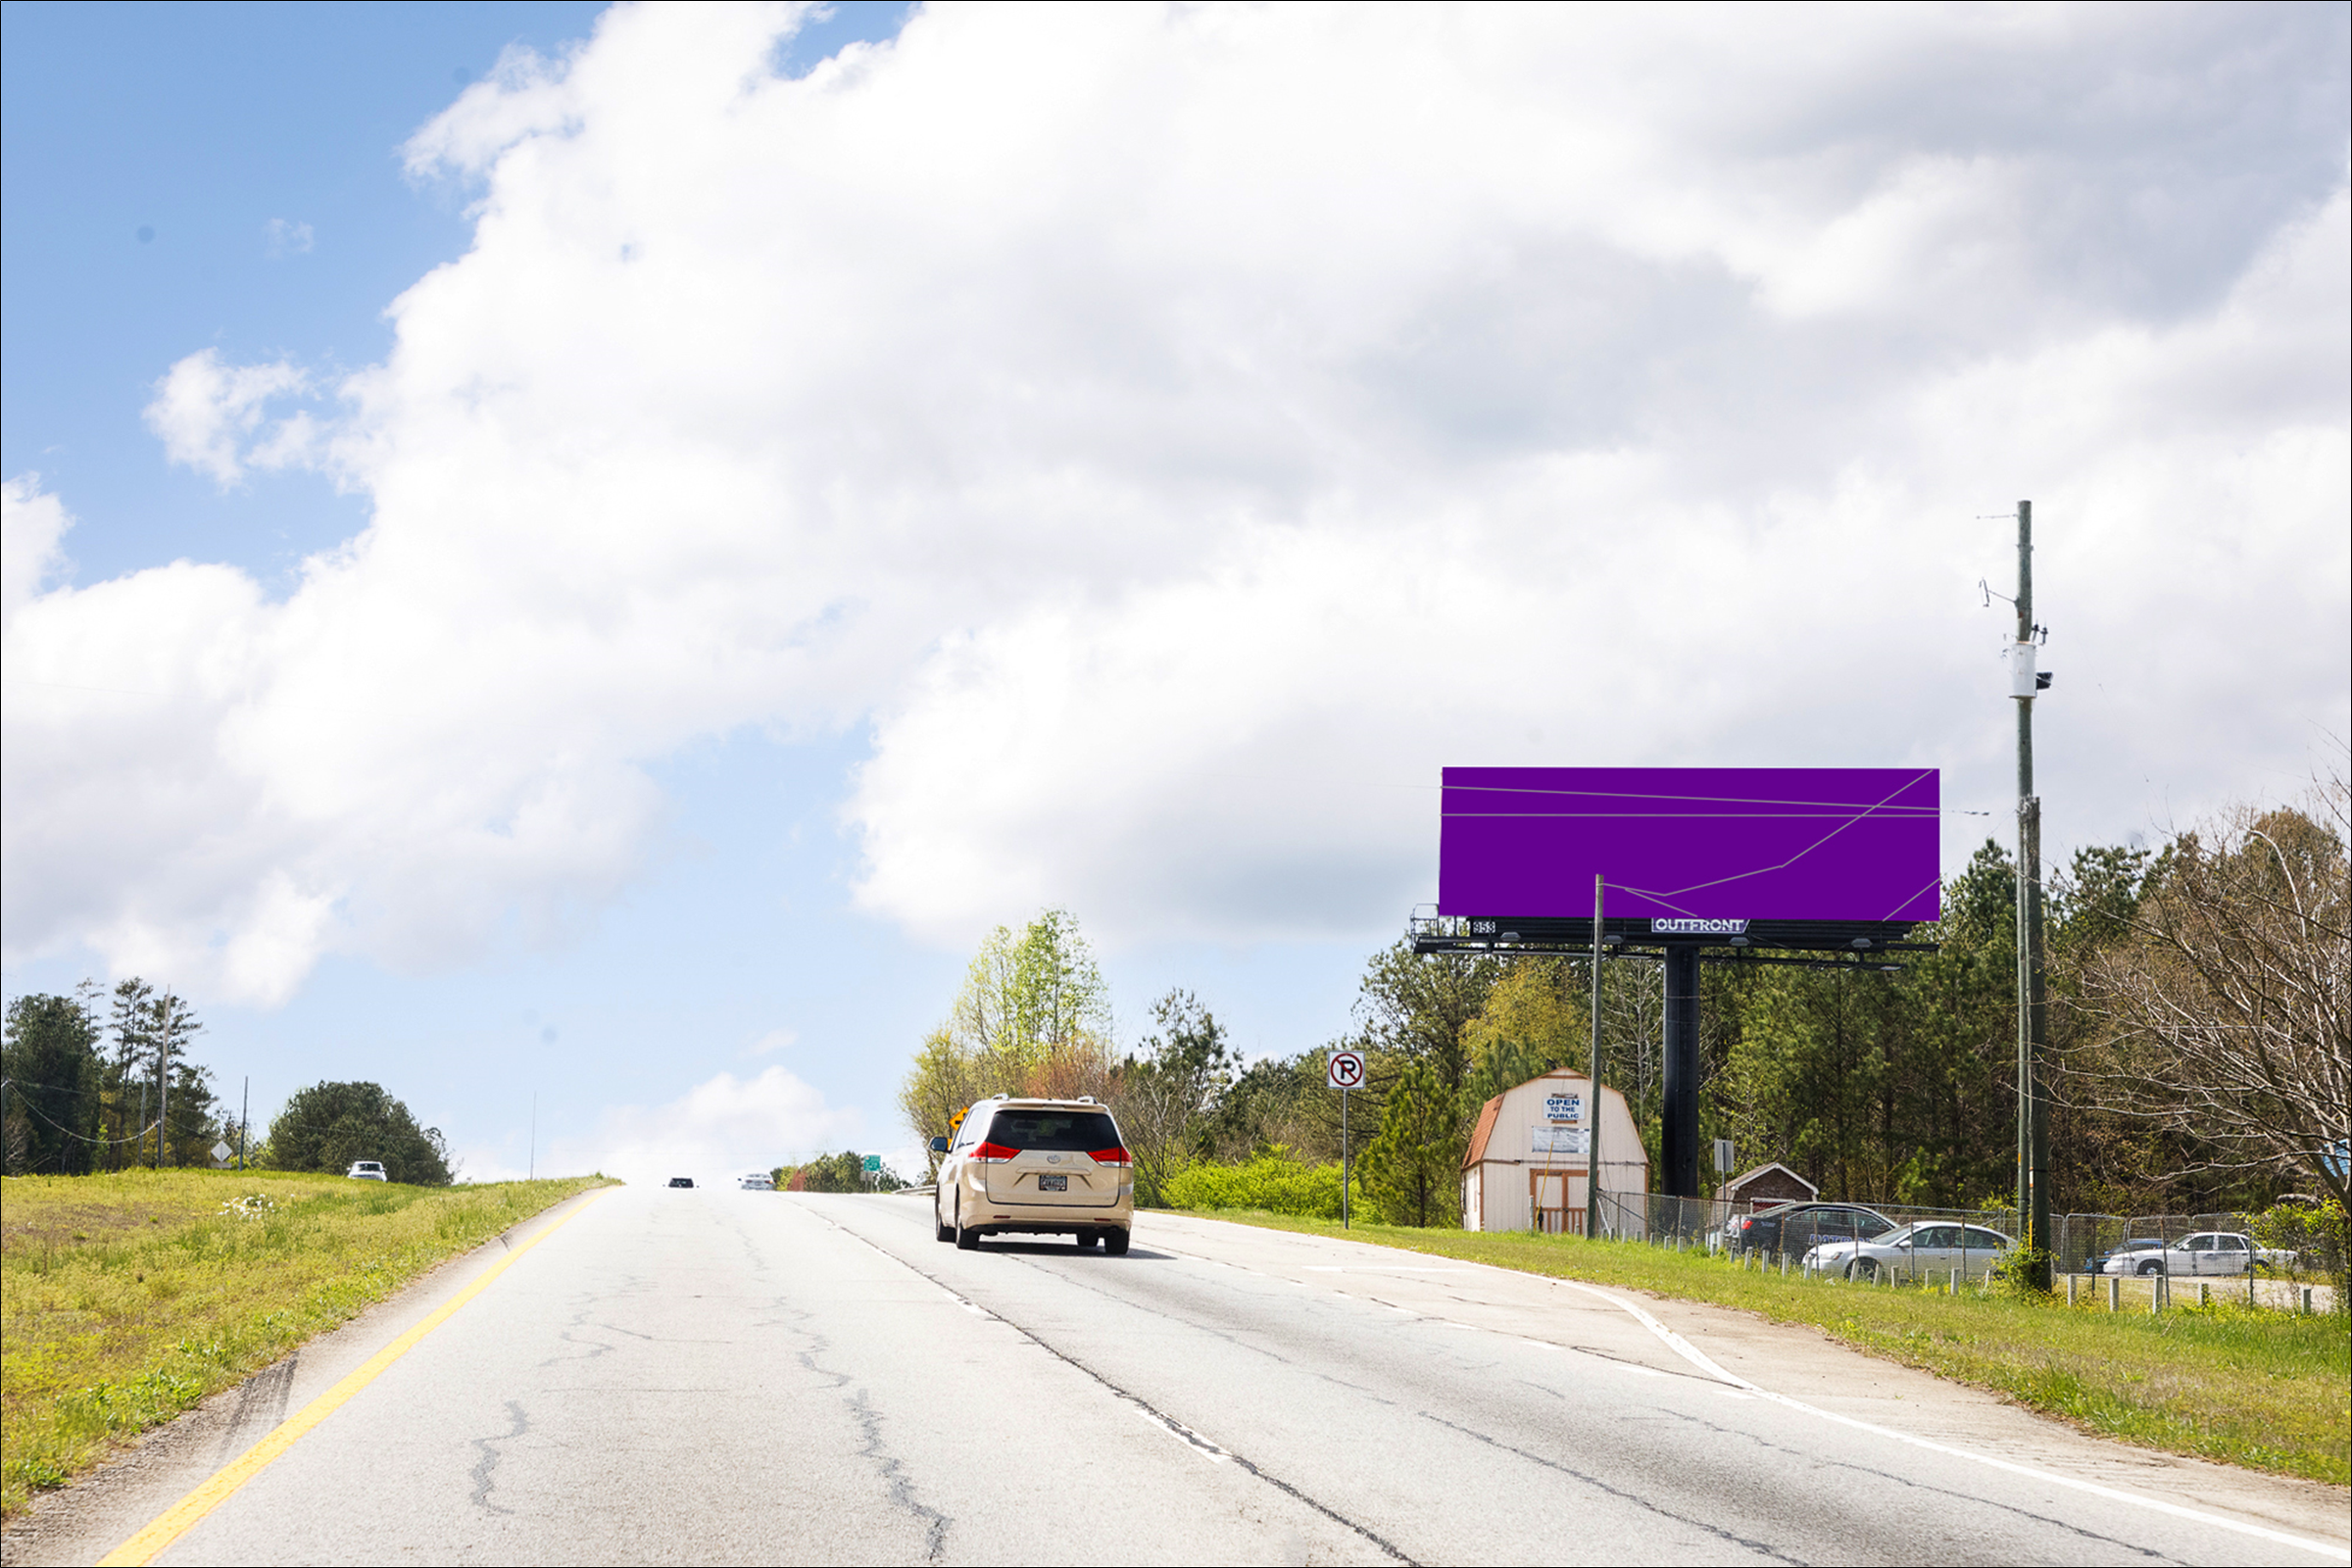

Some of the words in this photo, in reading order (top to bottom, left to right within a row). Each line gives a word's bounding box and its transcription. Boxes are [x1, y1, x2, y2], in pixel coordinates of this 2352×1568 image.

[1655, 918, 1744, 931] OUTFRONT
[1341, 1060, 1356, 1080] P
[1808, 1233, 1871, 1246] PATR
